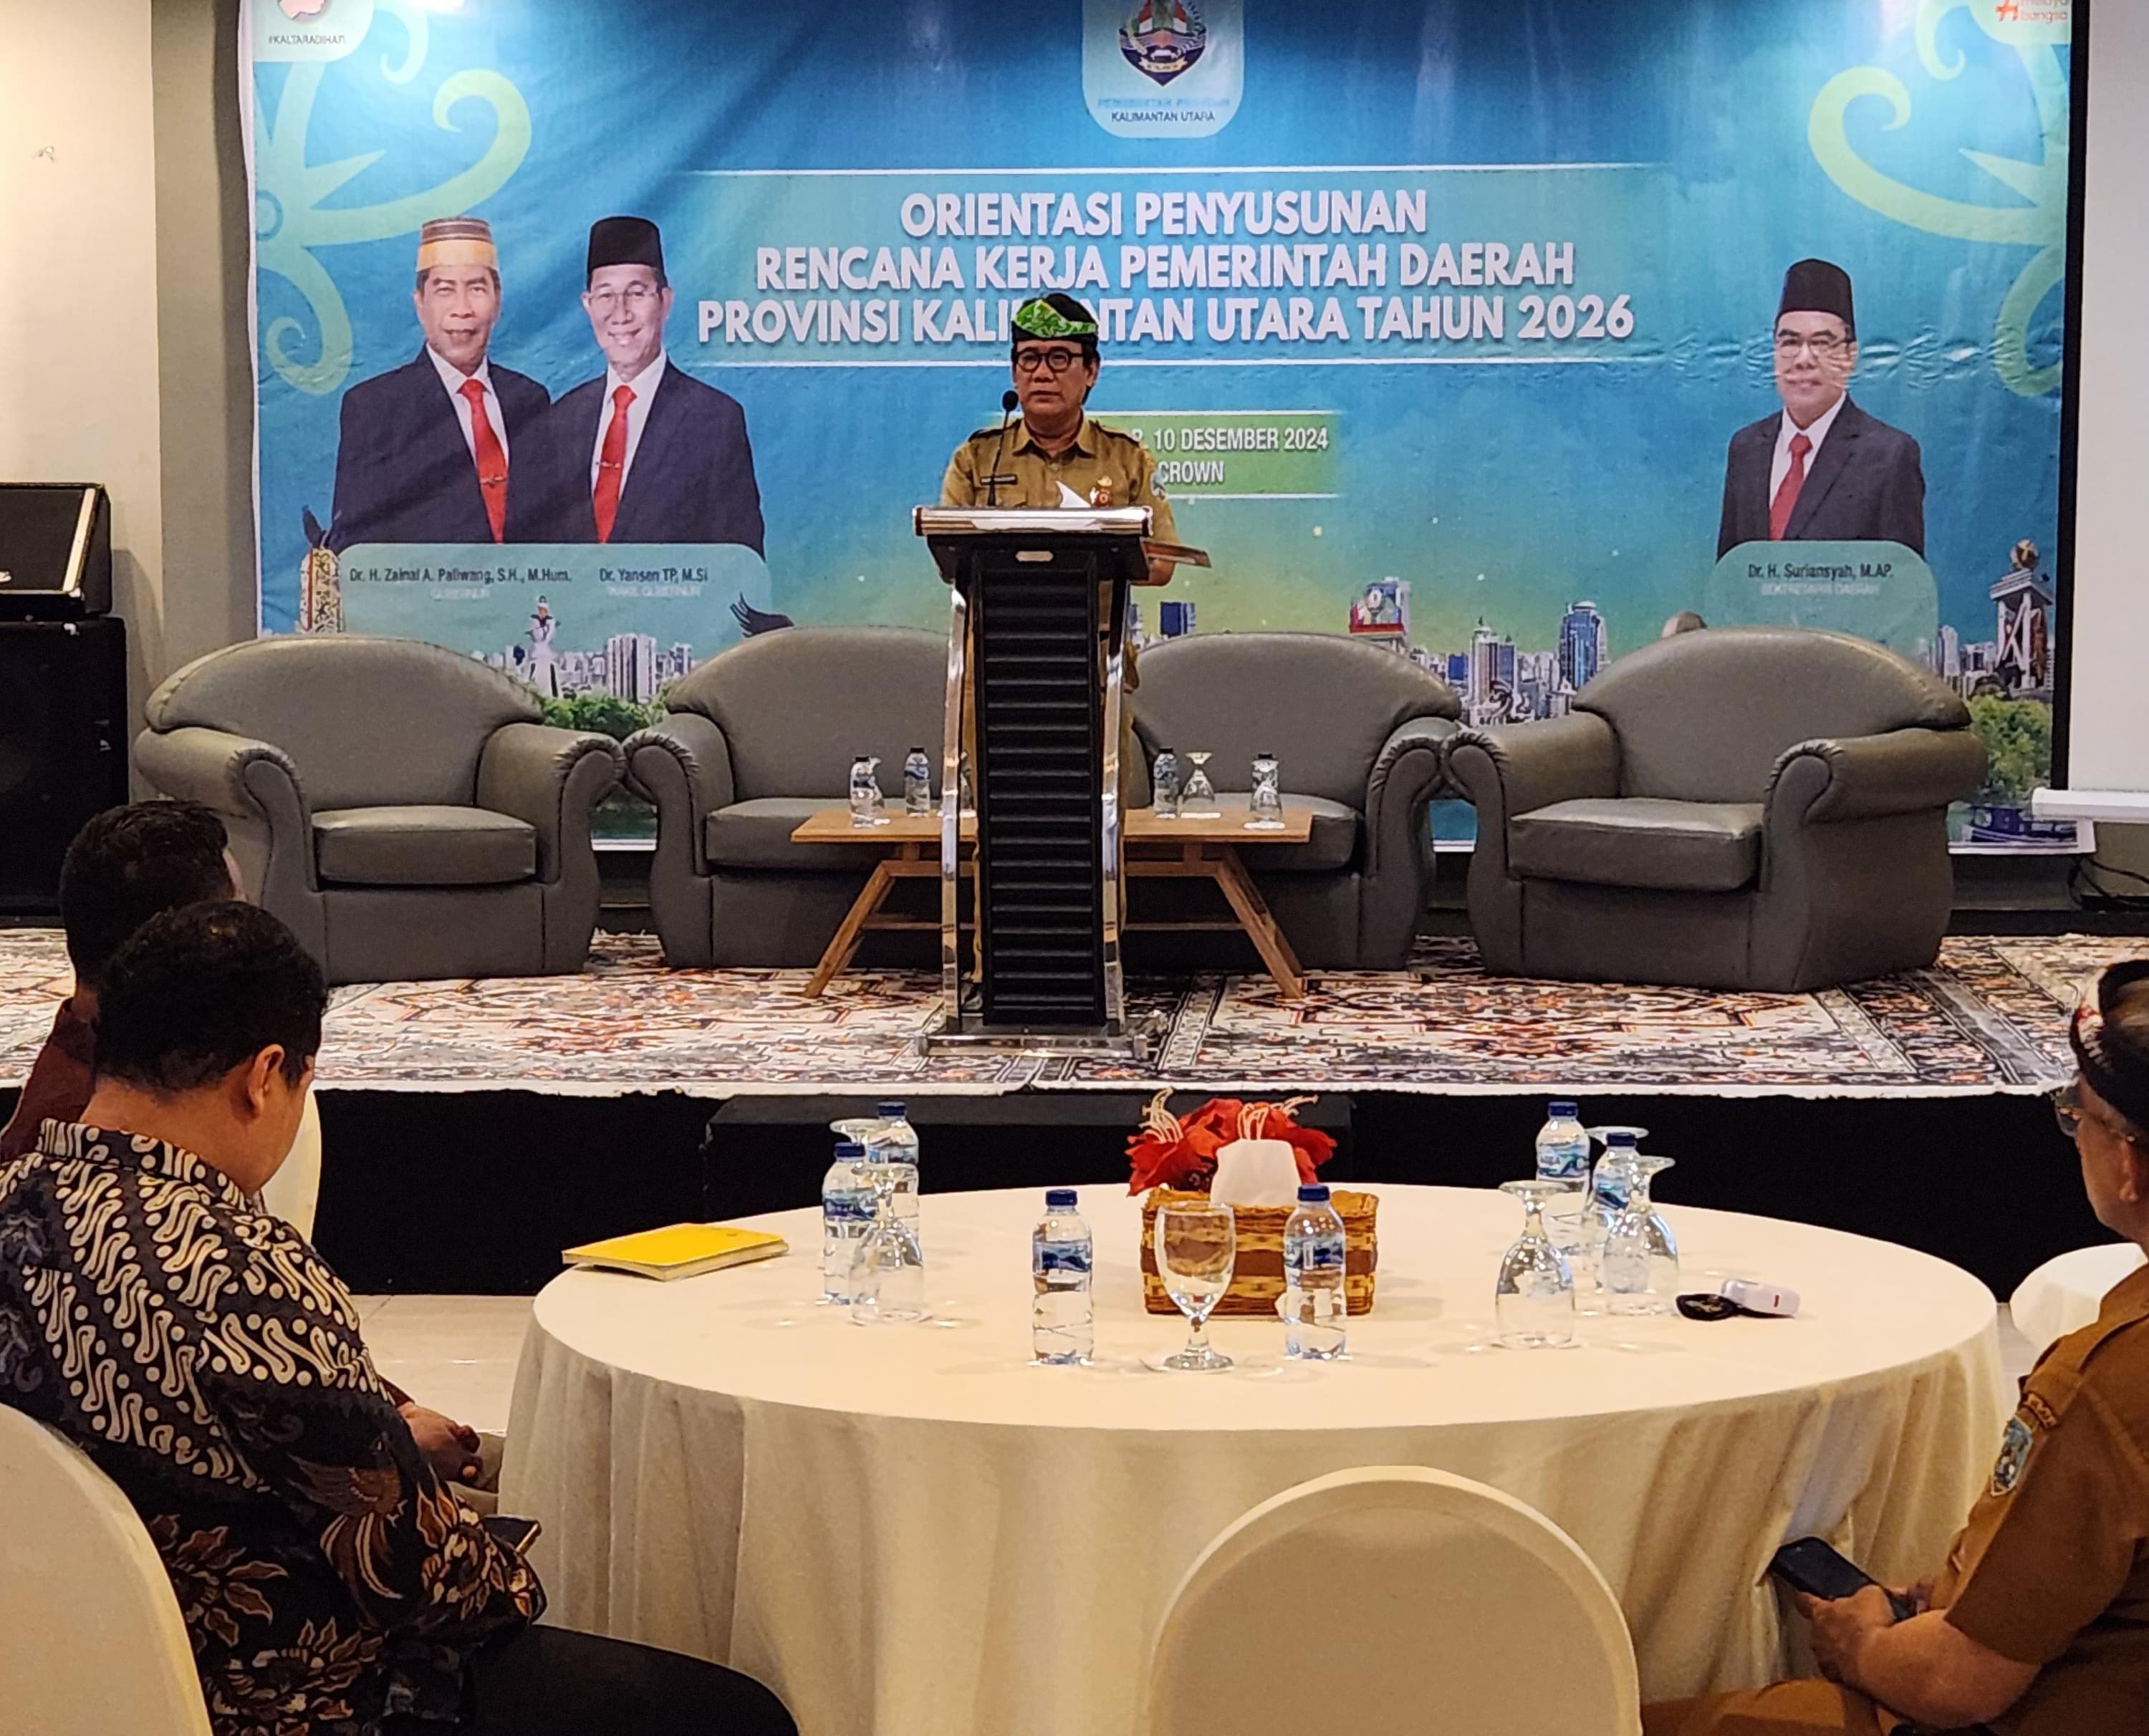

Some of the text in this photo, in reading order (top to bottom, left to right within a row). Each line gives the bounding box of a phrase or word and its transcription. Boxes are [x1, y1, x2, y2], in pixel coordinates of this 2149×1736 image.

[1111, 111, 1215, 122] KALIMANTAN UTARA
[900, 190, 1426, 236] ORIENTASI PENYUSUNAN
[757, 242, 1574, 290] RENCANA KERJA PEMERINTAH DAERAH
[698, 294, 1634, 343] PROVINSI KALINTAN UTARA TAHUN 2026
[1153, 428, 1176, 450] 10
[1181, 428, 1279, 450] DESEMBER
[1284, 426, 1329, 450] 2024
[1157, 460, 1224, 483] CROWN
[617, 568, 660, 582] Yansen
